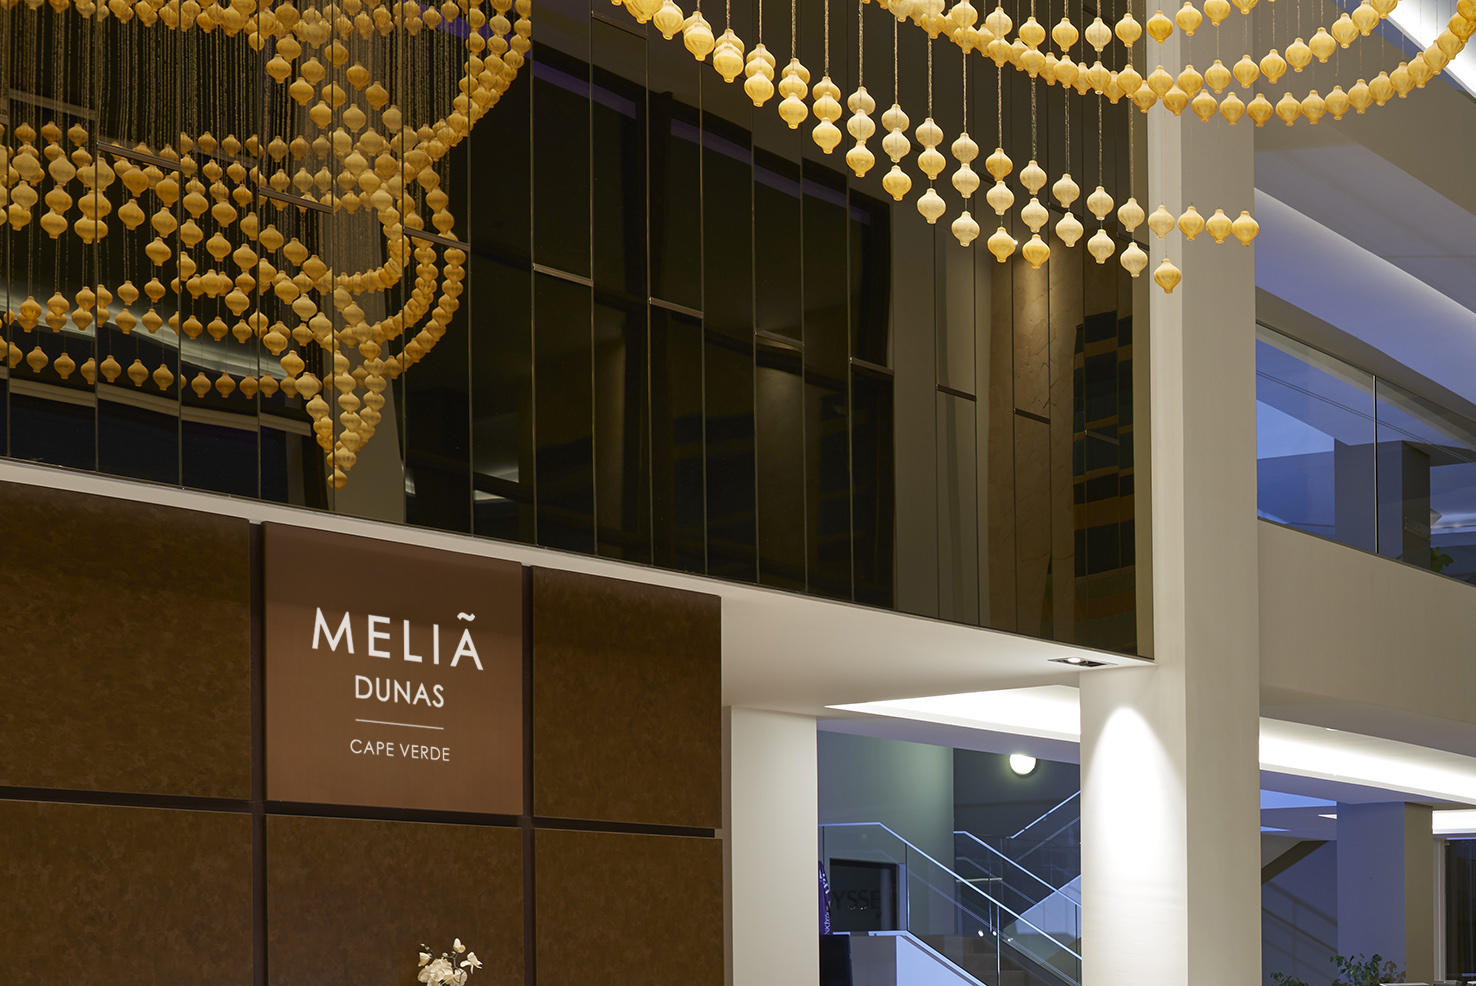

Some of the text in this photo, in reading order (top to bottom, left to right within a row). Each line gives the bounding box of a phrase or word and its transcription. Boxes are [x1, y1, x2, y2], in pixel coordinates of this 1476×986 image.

[355, 674, 445, 708] DUNAS
[349, 738, 451, 762] CAPE VERDE
